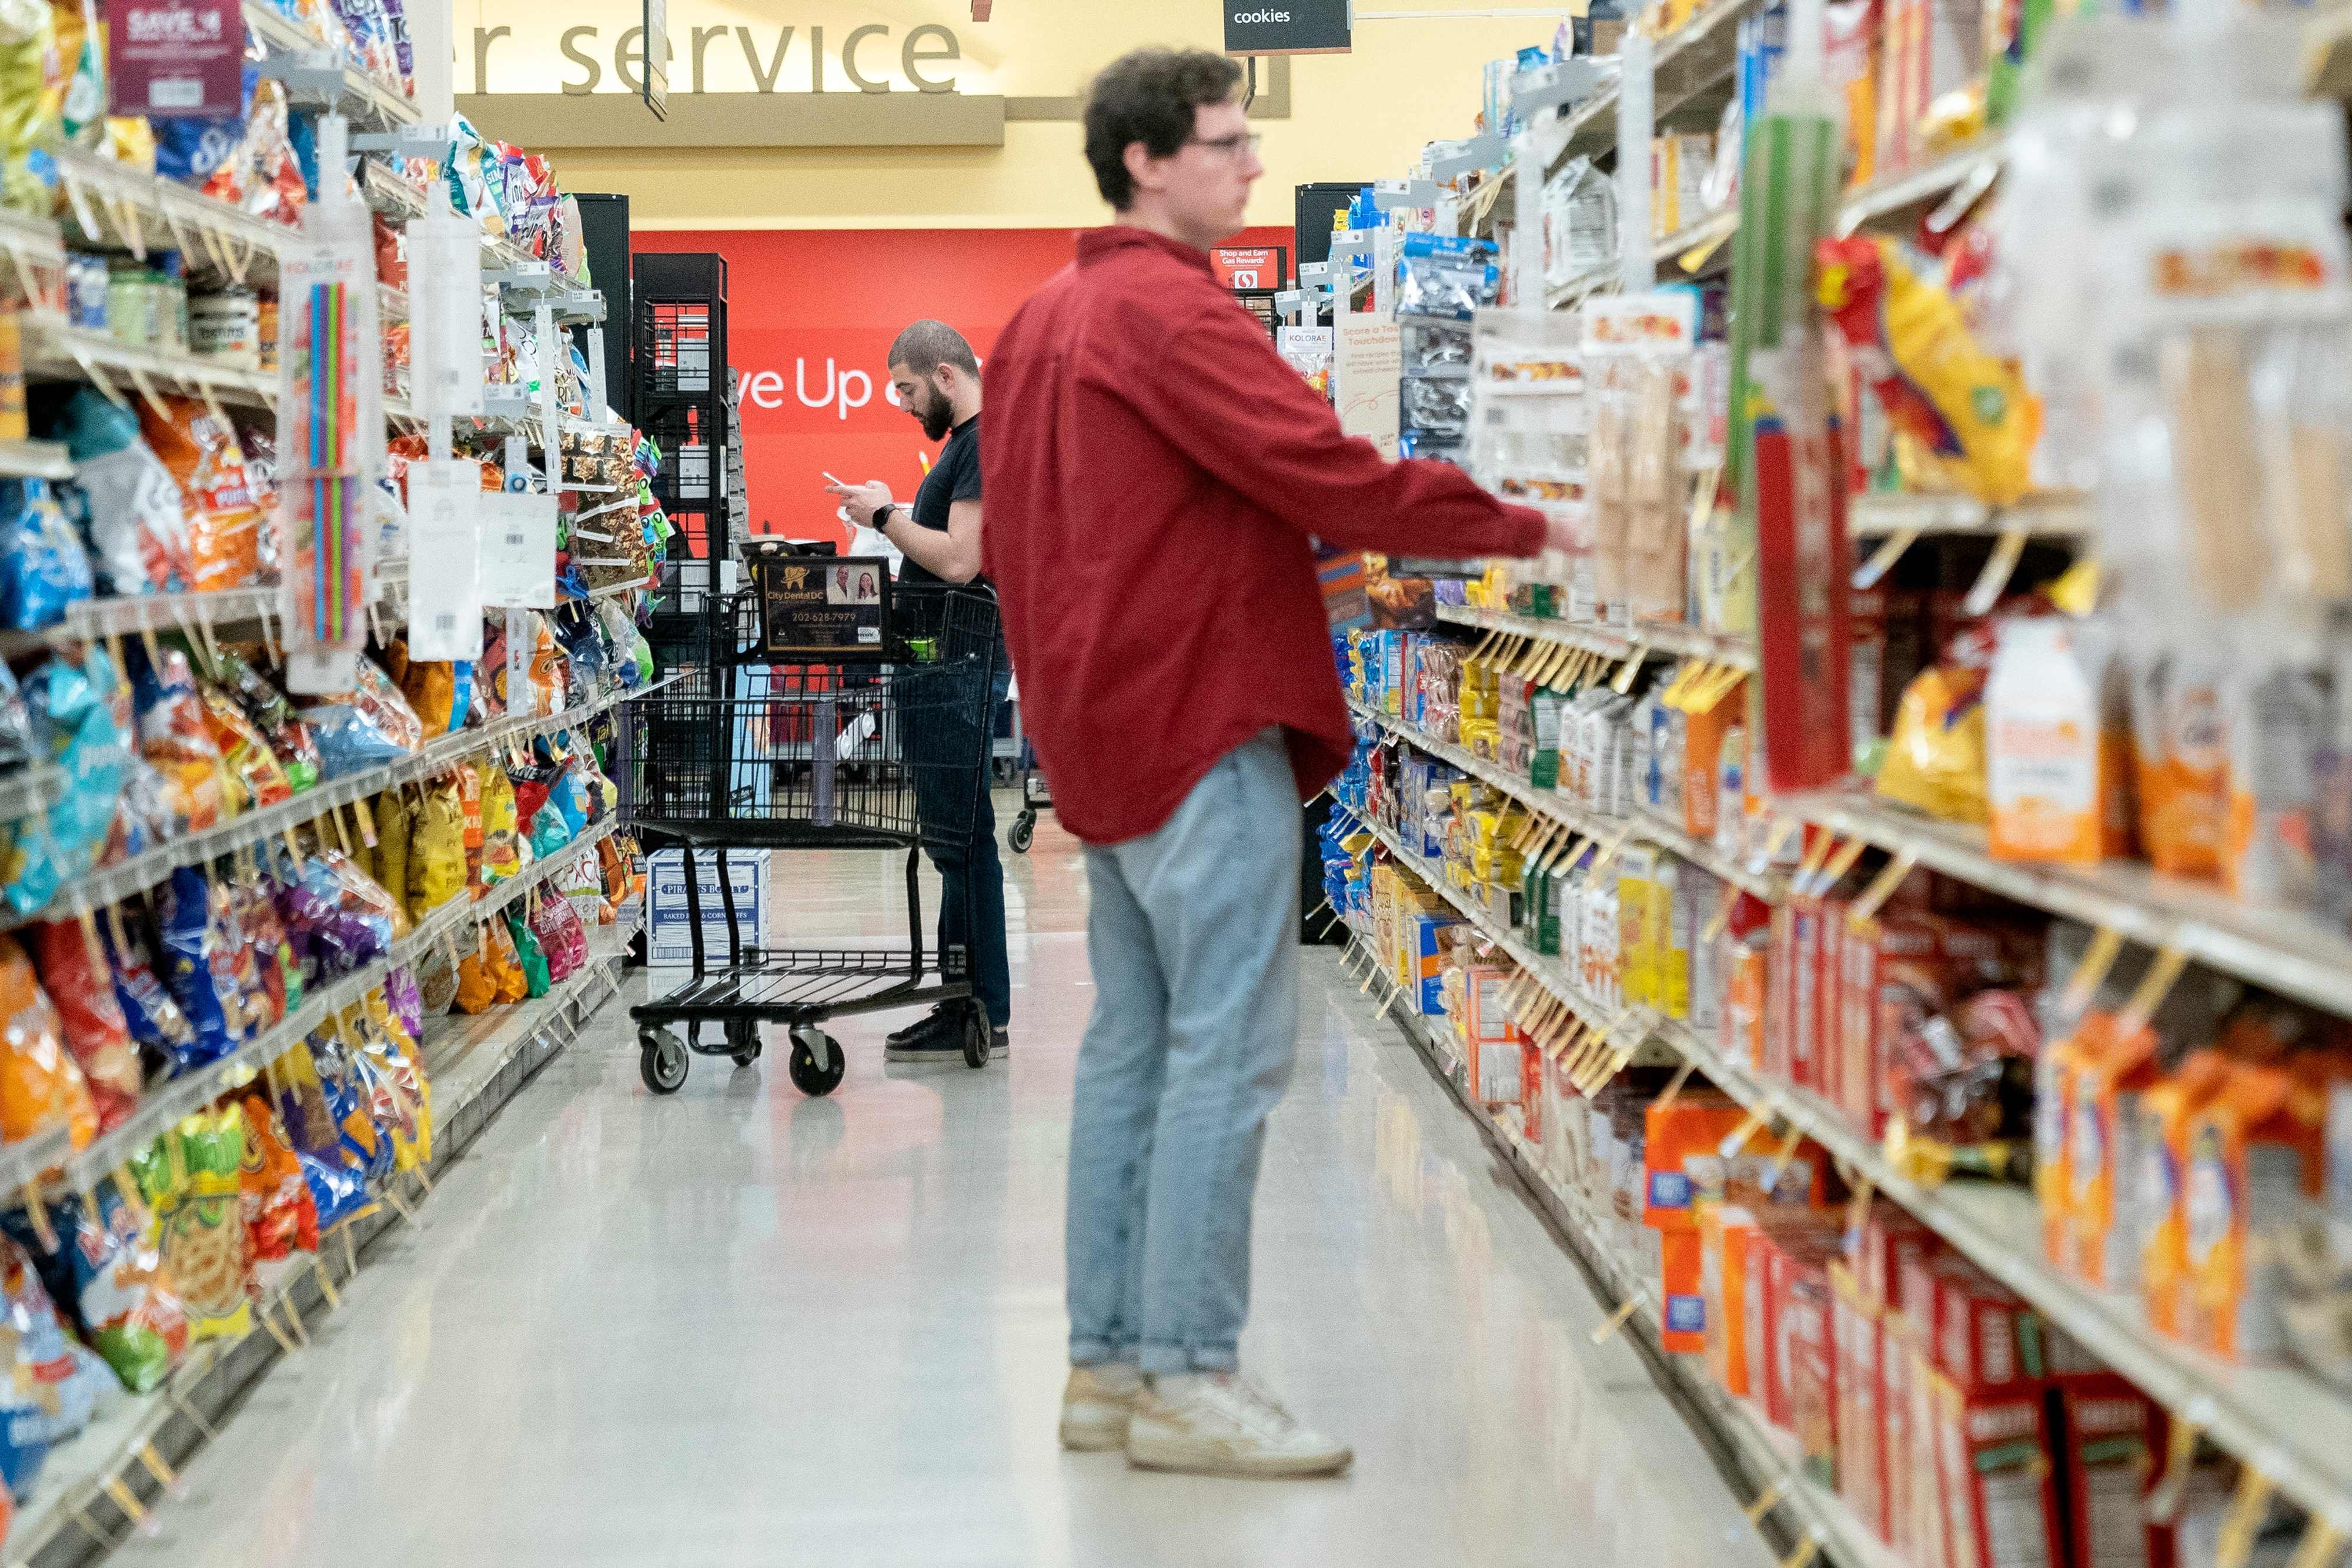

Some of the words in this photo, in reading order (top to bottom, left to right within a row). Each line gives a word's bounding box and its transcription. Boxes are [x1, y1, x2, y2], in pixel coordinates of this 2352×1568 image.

[1234, 8, 1291, 24] cookies
[560, 24, 960, 94] service
[1343, 329, 1370, 337] Score
[796, 357, 873, 420] Up
[767, 592, 783, 600] City
[784, 591, 810, 600] Dental
